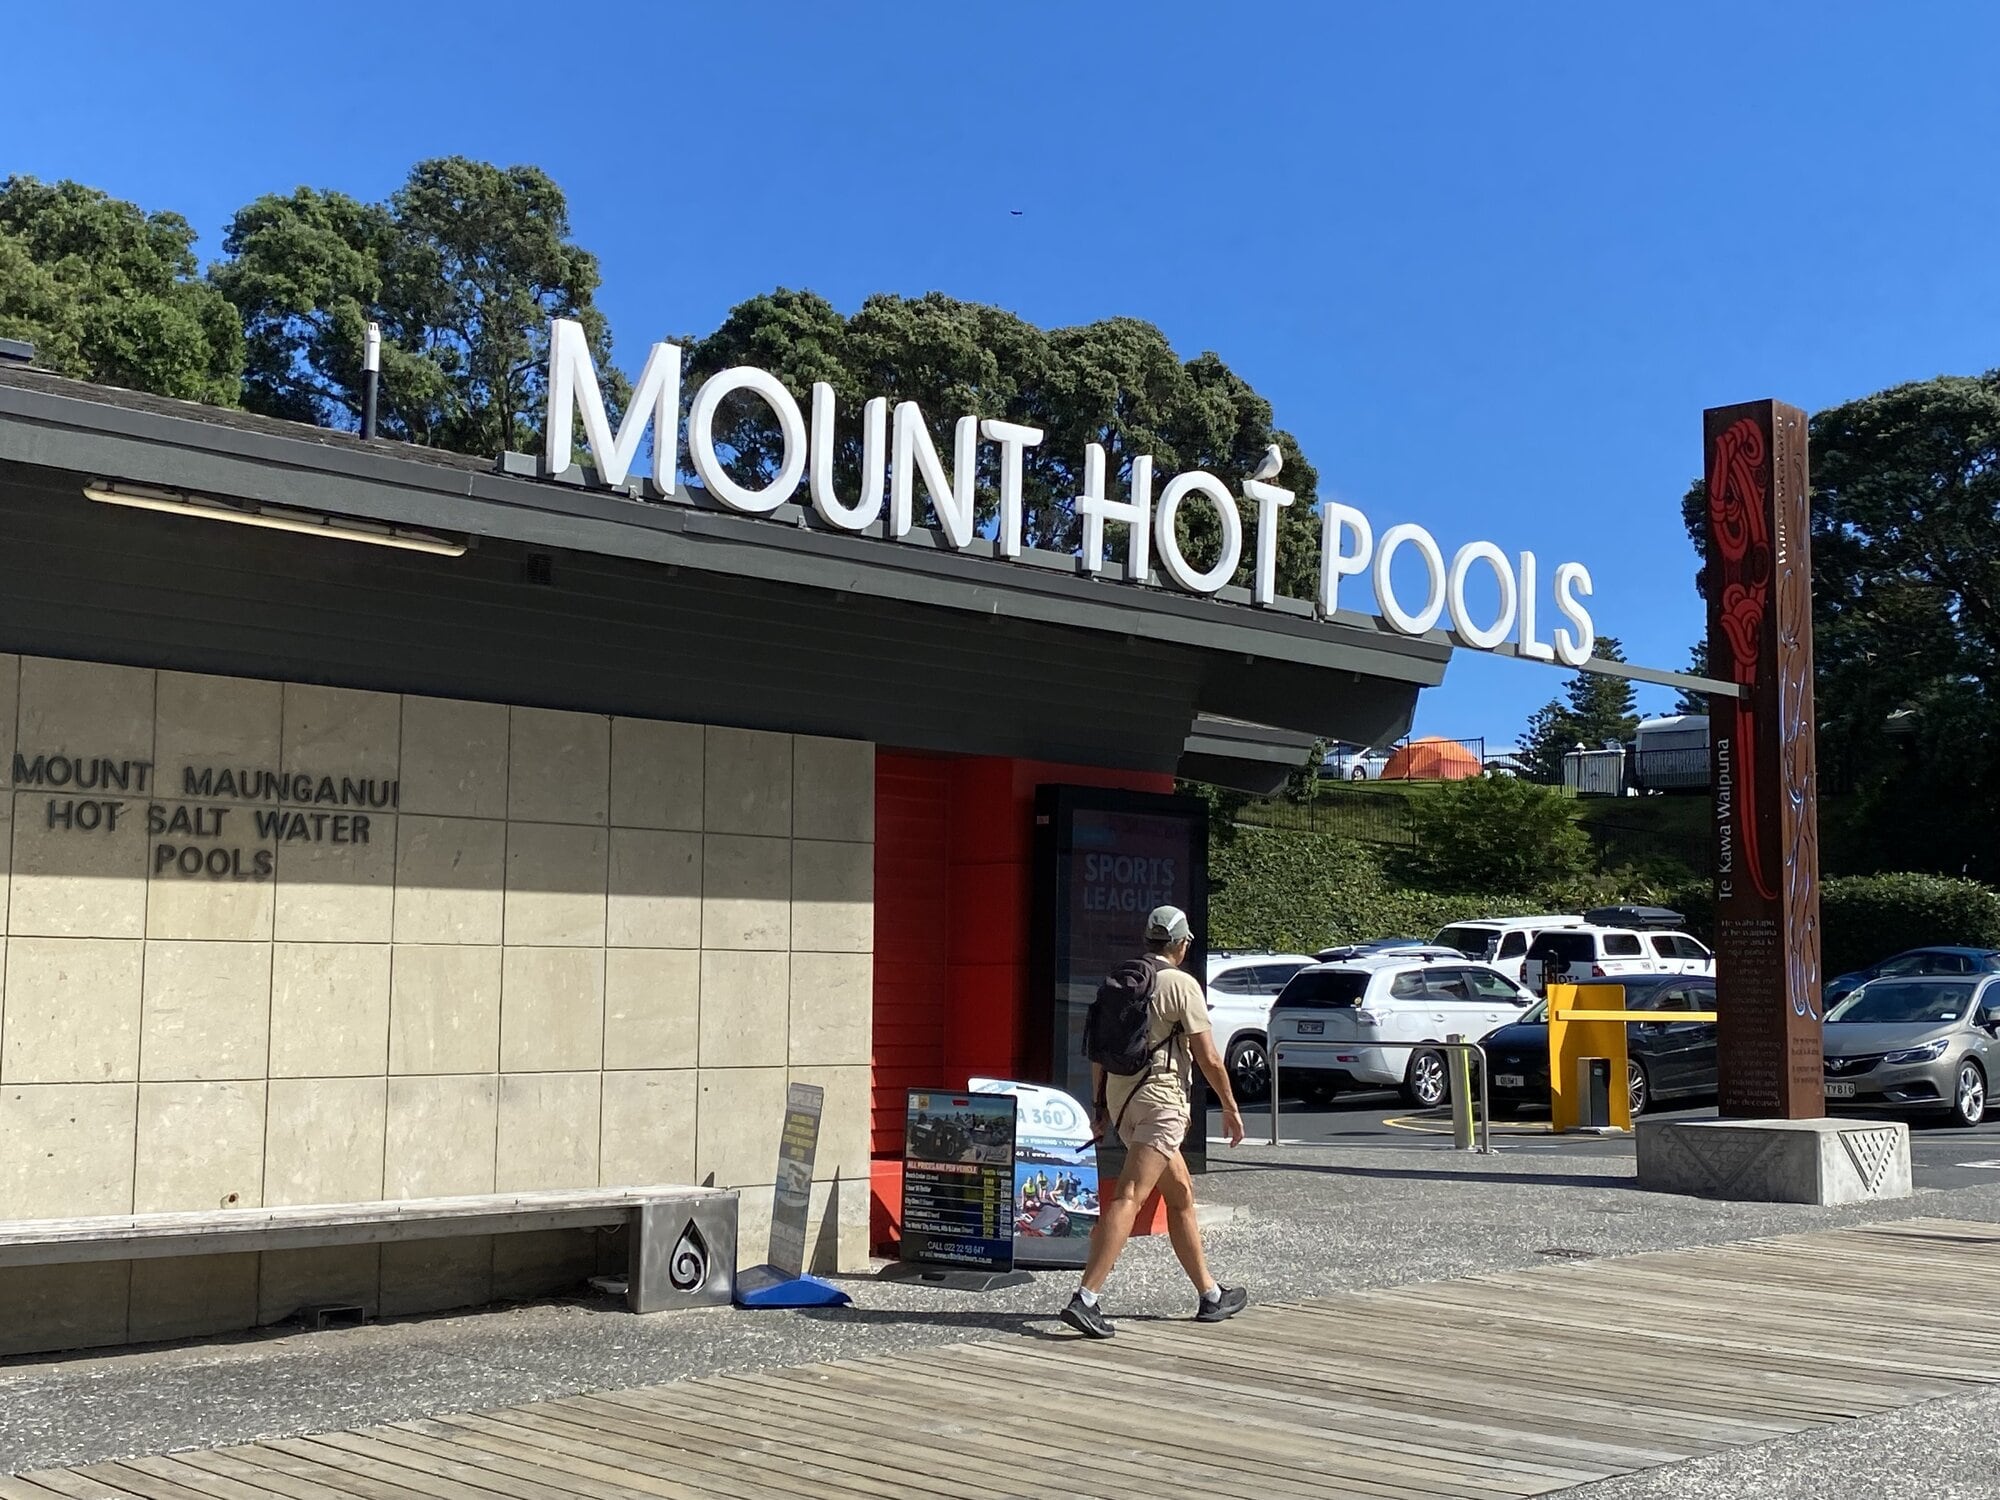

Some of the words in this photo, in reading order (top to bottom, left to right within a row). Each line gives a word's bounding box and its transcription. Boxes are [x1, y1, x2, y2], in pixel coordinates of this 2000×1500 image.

[545, 318, 1044, 558] MOUNT
[1075, 442, 1295, 605] HOT
[1320, 502, 1594, 666] POOLS
[14, 752, 154, 792] MOUNT
[184, 766, 400, 809] MAUNGANUI
[1717, 738, 1732, 820] Waipuna
[48, 799, 124, 832] HOT
[147, 805, 230, 837] SALT
[256, 809, 371, 844] WATER
[154, 844, 274, 880] POOLS
[1718, 824, 1732, 874] Kawa
[1084, 853, 1176, 886] SPORTS
[1718, 879, 1732, 901] Te
[1536, 974, 1580, 984] TOTA
[1825, 1084, 1854, 1094] TY816
[927, 1241, 943, 1250] CALL
